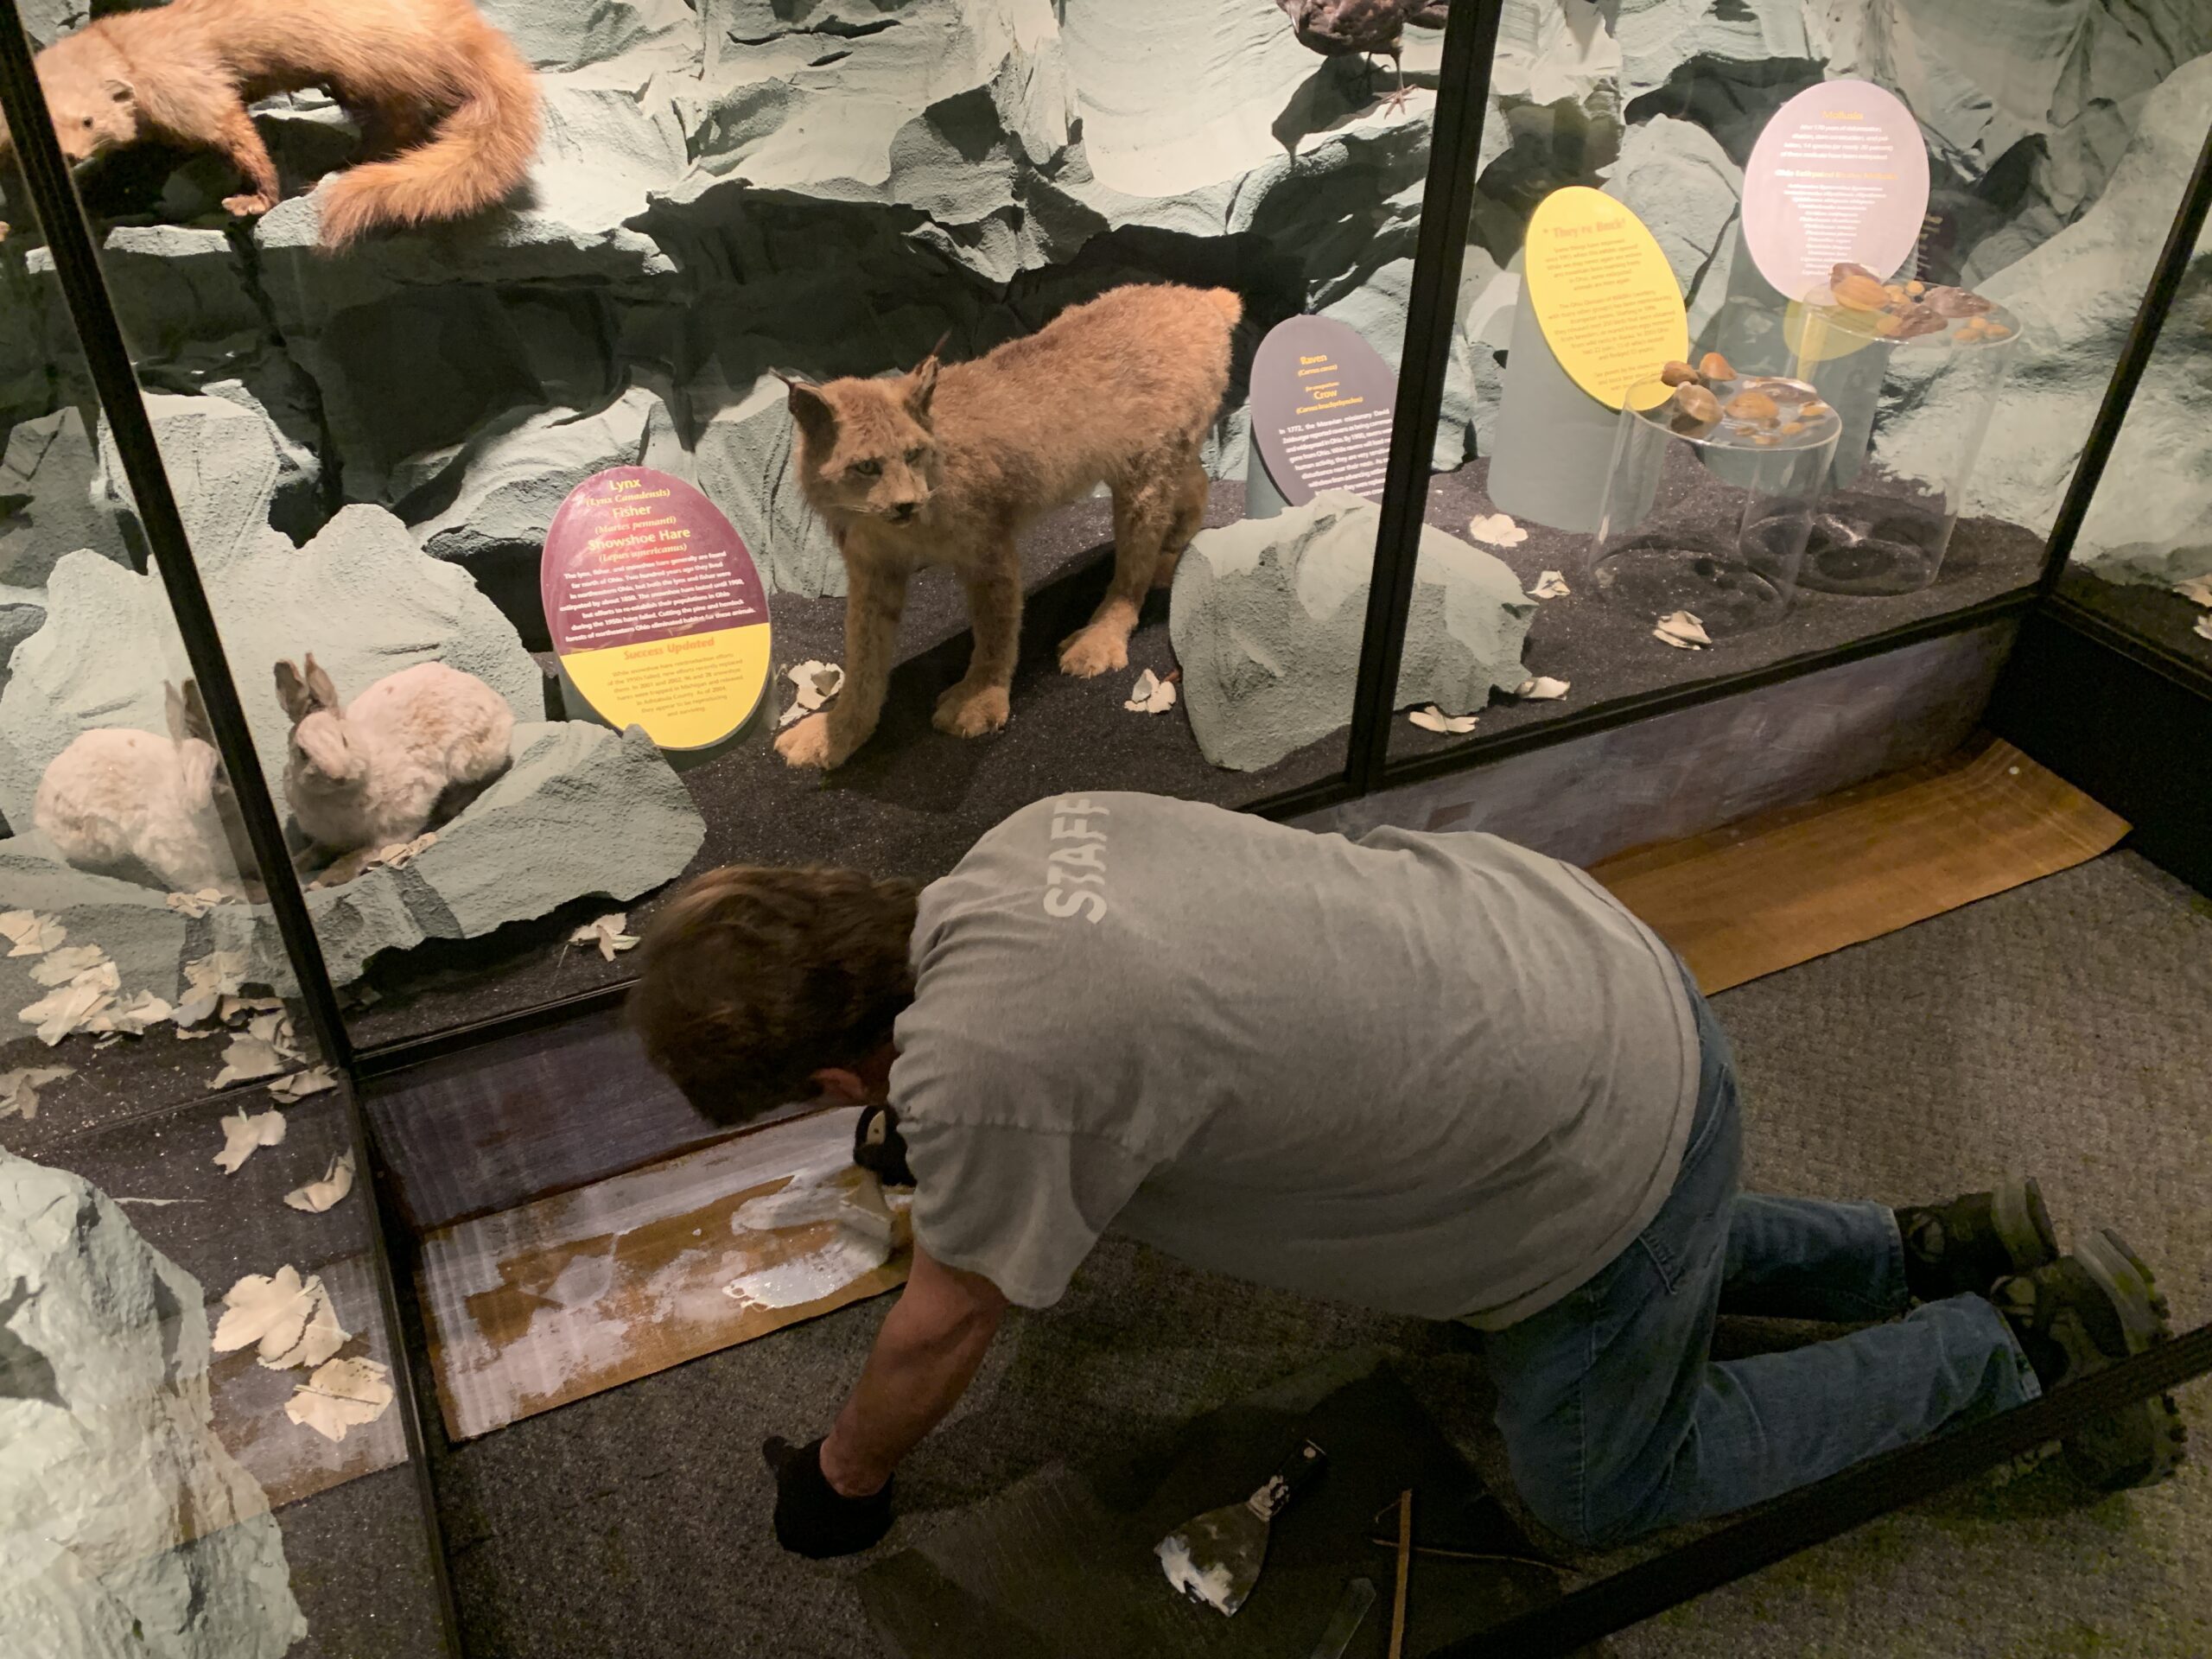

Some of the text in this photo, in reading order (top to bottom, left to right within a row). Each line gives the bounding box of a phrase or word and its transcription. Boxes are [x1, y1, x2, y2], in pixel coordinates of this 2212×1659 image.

[1300, 354, 1327, 365] Raven
[1313, 390, 1338, 400] Crow
[609, 478, 641, 493] Lynx
[586, 488, 671, 508] (Lynx Canadensis)
[612, 505, 652, 518] Fisher
[658, 528, 691, 542] Hare
[624, 637, 715, 660] Success Updated
[1043, 798, 1110, 925] STAFF
